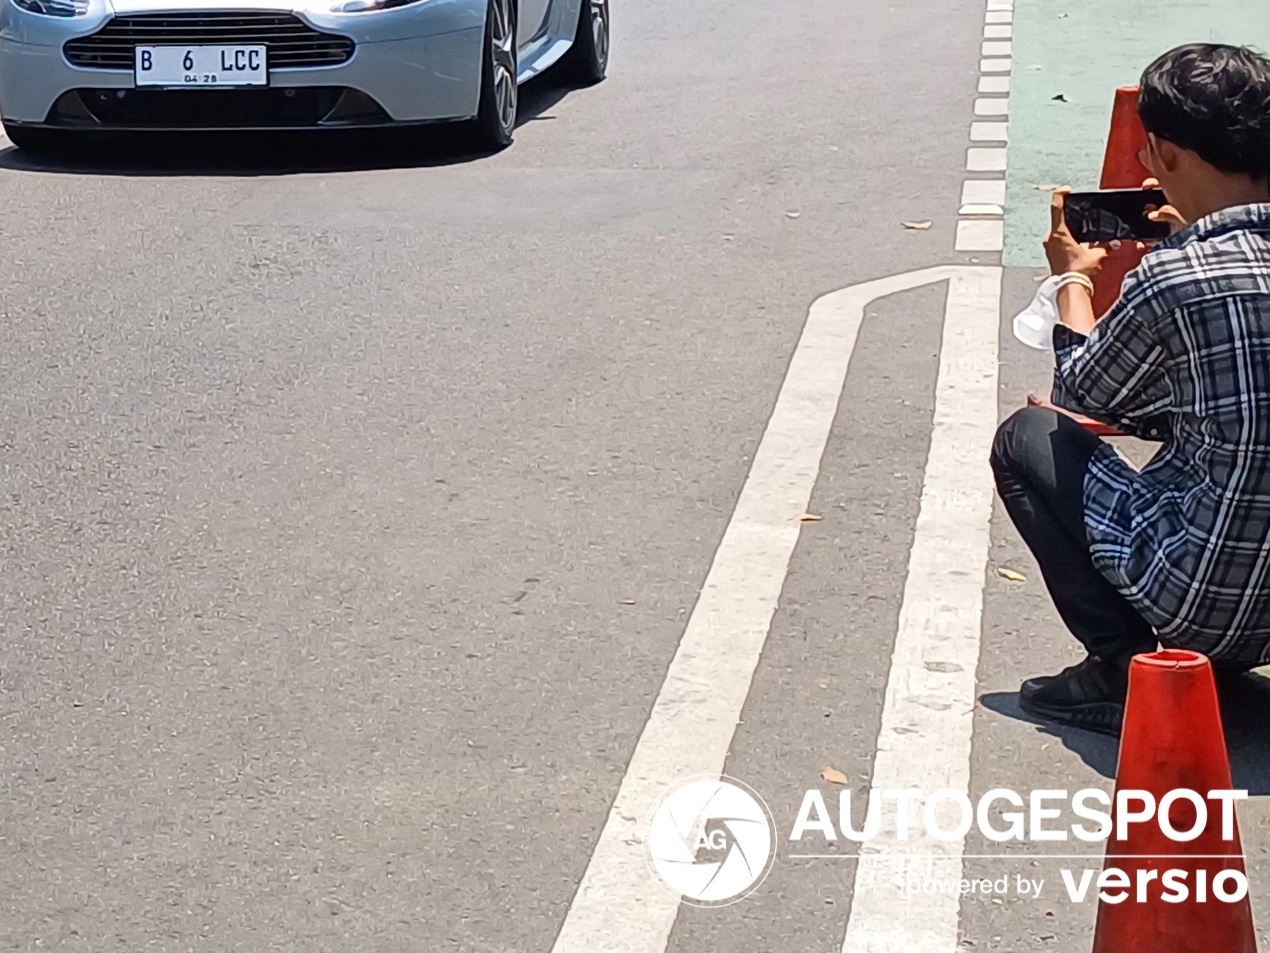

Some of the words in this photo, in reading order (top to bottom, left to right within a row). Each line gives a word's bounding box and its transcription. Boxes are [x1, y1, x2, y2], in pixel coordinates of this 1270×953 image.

[141, 50, 153, 71] B
[183, 50, 194, 71] 6
[221, 50, 261, 71] LCC
